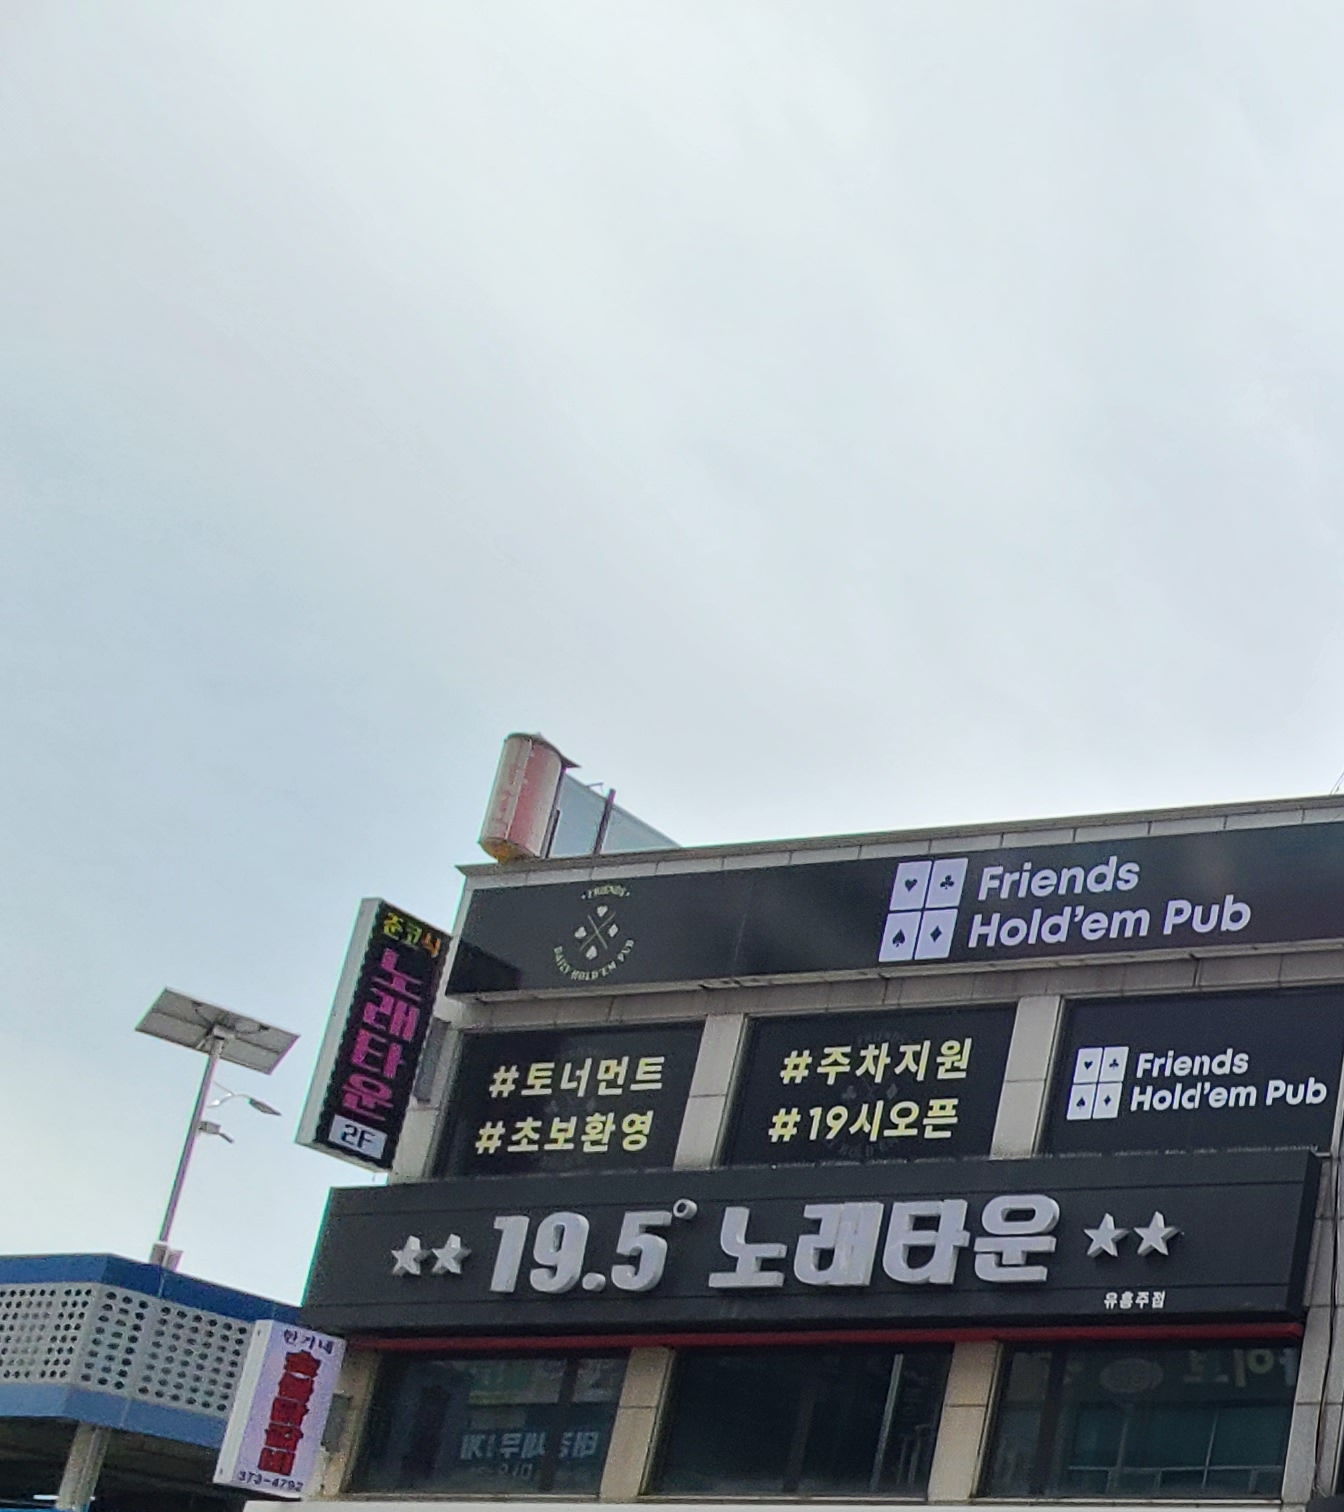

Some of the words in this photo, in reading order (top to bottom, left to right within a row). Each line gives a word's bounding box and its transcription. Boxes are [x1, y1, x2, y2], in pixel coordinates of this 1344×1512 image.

[978, 855, 1140, 902] Friends
[968, 905, 1151, 949] Hold'em
[1163, 895, 1252, 936] Pub
[341, 947, 420, 1121] 노래타운
[489, 1055, 665, 1098] #토너먼트
[780, 1038, 973, 1085] #주차지원
[1135, 1048, 1250, 1079] Friends
[1130, 1080, 1257, 1113] Hold'em
[1266, 1077, 1328, 1106] Pub
[341, 1124, 376, 1151] 2F
[475, 1111, 654, 1154] #초보환영
[768, 1098, 960, 1143] #19시오픈
[708, 1193, 1061, 1290] 노래타운
[1104, 1290, 1166, 1309] 유흥주점
